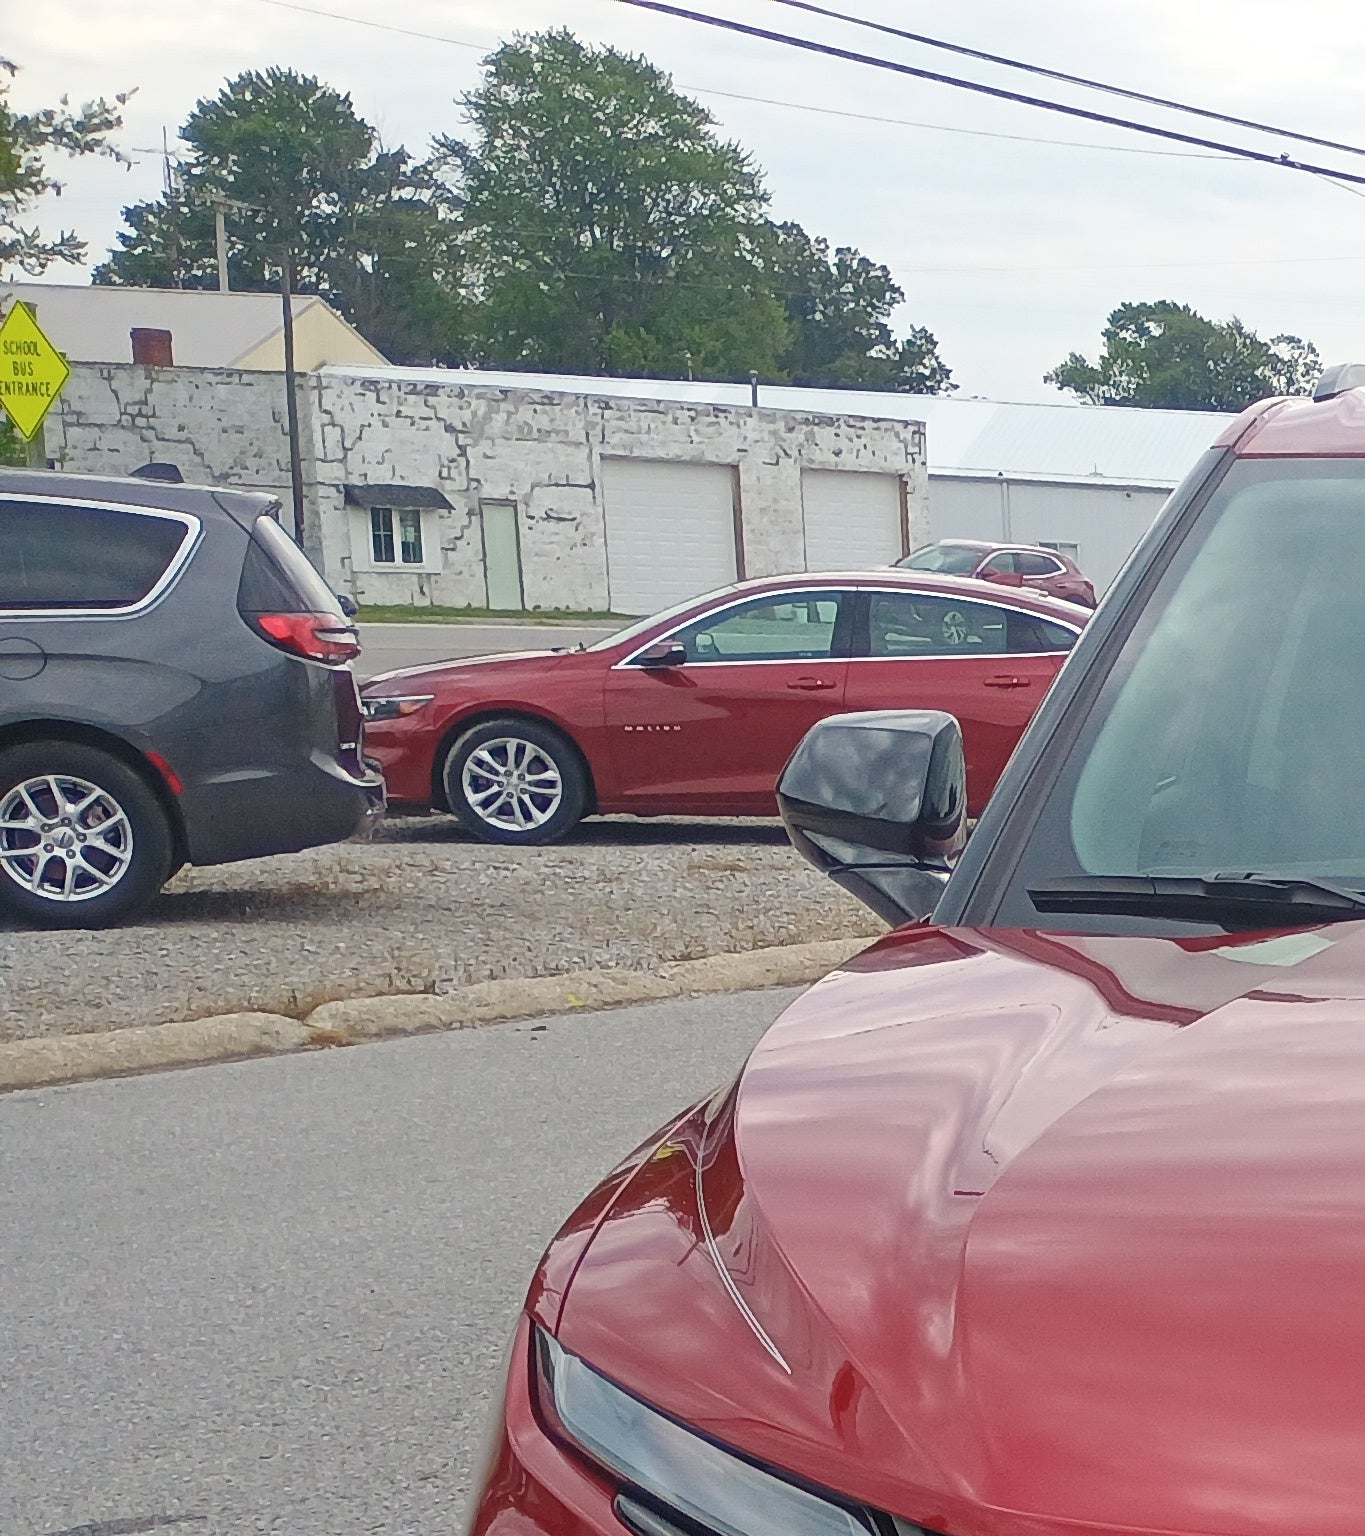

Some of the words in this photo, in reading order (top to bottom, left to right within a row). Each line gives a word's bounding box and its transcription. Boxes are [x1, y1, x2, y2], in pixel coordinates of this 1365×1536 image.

[3, 340, 41, 357] SCHOOL
[13, 361, 34, 377] BUS
[0, 380, 51, 398] ENTRANCE
